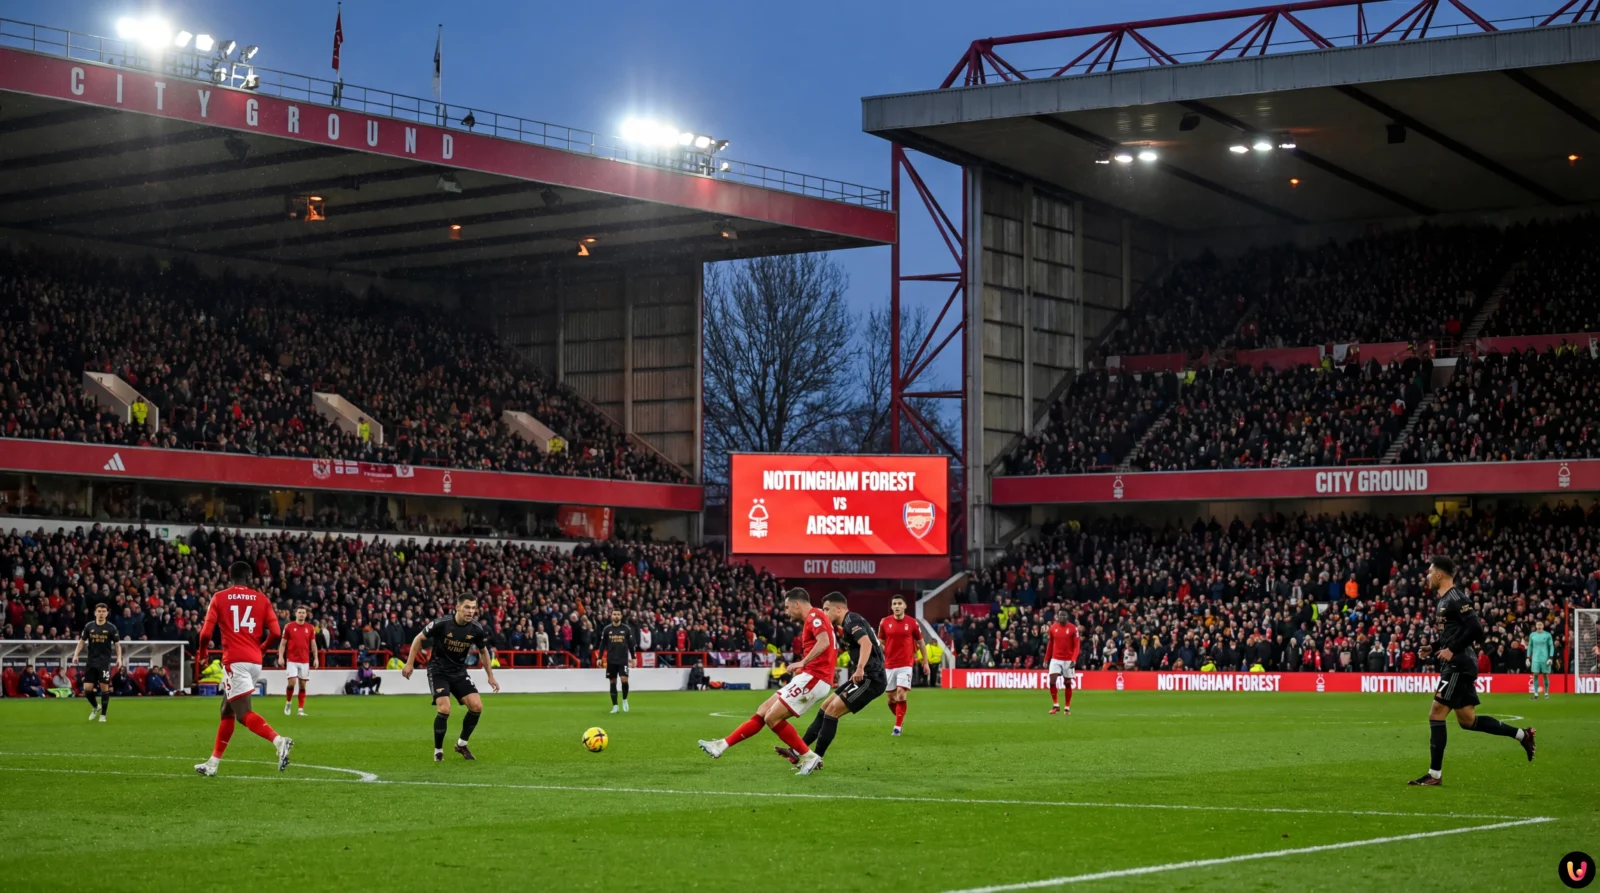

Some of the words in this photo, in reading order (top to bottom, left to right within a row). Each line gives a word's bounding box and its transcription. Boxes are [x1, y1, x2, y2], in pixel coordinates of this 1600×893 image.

[71, 67, 211, 118] CITY
[246, 98, 453, 159] GROUND
[763, 470, 858, 491] NOTTINGHAM
[861, 472, 916, 491] FOREST
[1316, 471, 1354, 493] CITY
[1358, 469, 1428, 492] GROUND
[833, 497, 847, 511] VS
[806, 515, 873, 535] ARSENAL
[804, 560, 829, 574] CITY
[832, 560, 876, 574] GROUND
[230, 605, 256, 633] 14
[966, 672, 1037, 689] NOTTINGHAM
[1158, 674, 1234, 691] NOTTINGHAM
[1236, 675, 1281, 692] FOREST
[1438, 680, 1449, 692] 7
